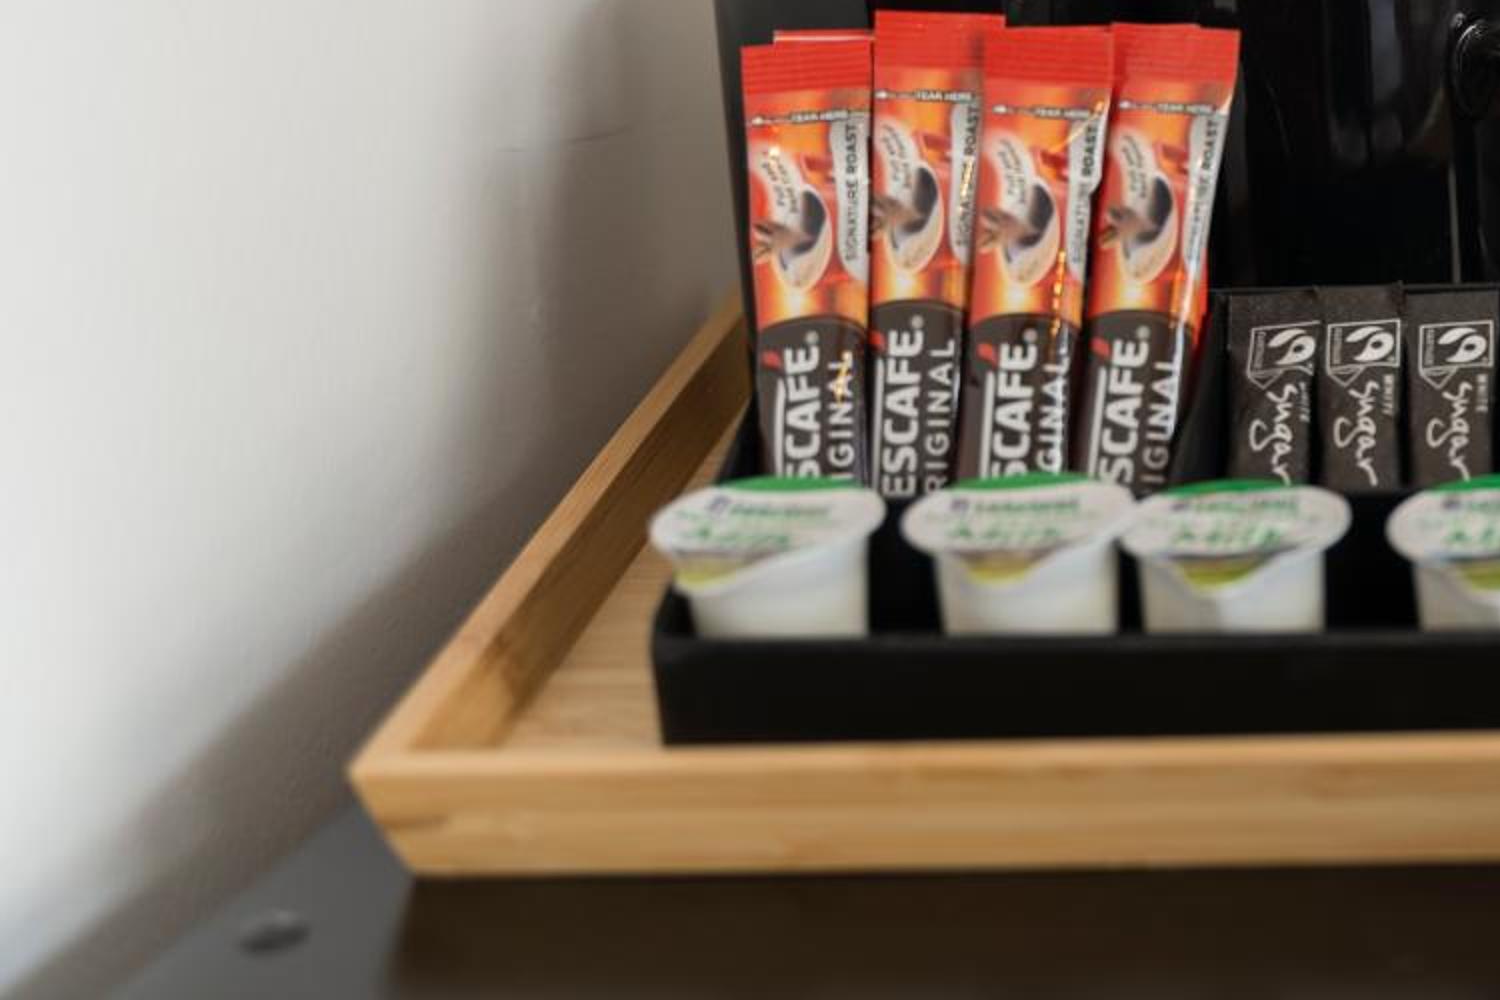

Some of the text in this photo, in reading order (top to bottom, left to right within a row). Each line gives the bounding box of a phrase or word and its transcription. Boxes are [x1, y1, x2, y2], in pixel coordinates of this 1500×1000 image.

[963, 105, 979, 156] ROAST
[1081, 126, 1096, 178] ROAST
[1200, 120, 1217, 172] ROAST
[844, 123, 858, 262] SIGNATURE ROAST
[826, 351, 855, 479] IGINAL
[868, 328, 924, 498] ESCAFÉ
[923, 338, 956, 495] RIGINAL
[1035, 356, 1070, 474] GINAL
[1090, 338, 1150, 484] SCAFÉ
[1141, 352, 1179, 484] IGINAL
[1250, 383, 1299, 487] sugar
[1333, 380, 1379, 487] sugar
[1426, 380, 1474, 483] sugar
